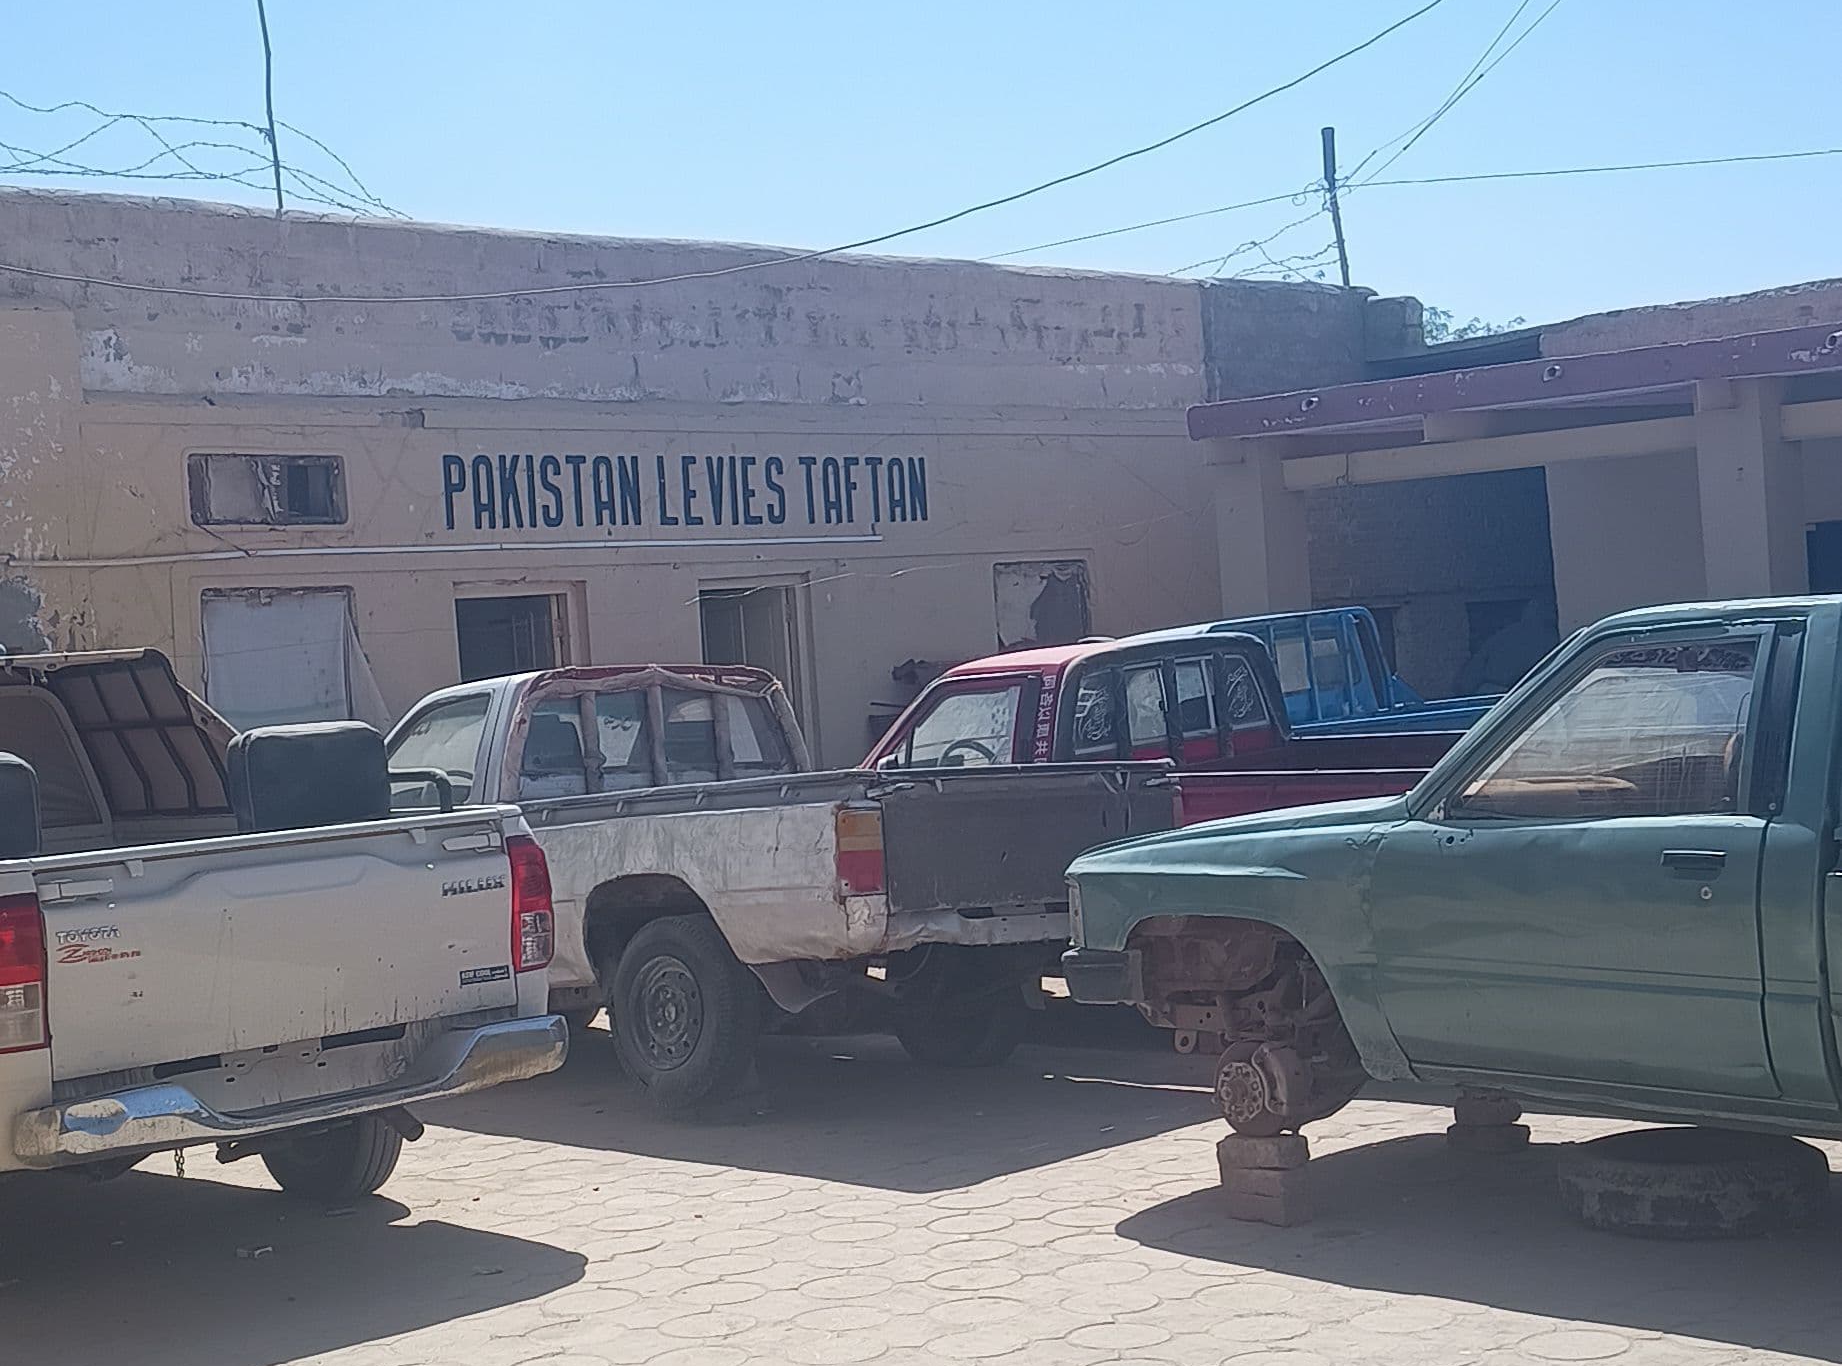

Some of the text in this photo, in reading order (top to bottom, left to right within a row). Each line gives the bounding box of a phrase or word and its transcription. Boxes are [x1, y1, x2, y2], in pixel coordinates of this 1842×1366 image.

[442, 454, 929, 530] PAKISTAN LEVIES TAFTAN
[56, 924, 121, 944] TOYOTA
